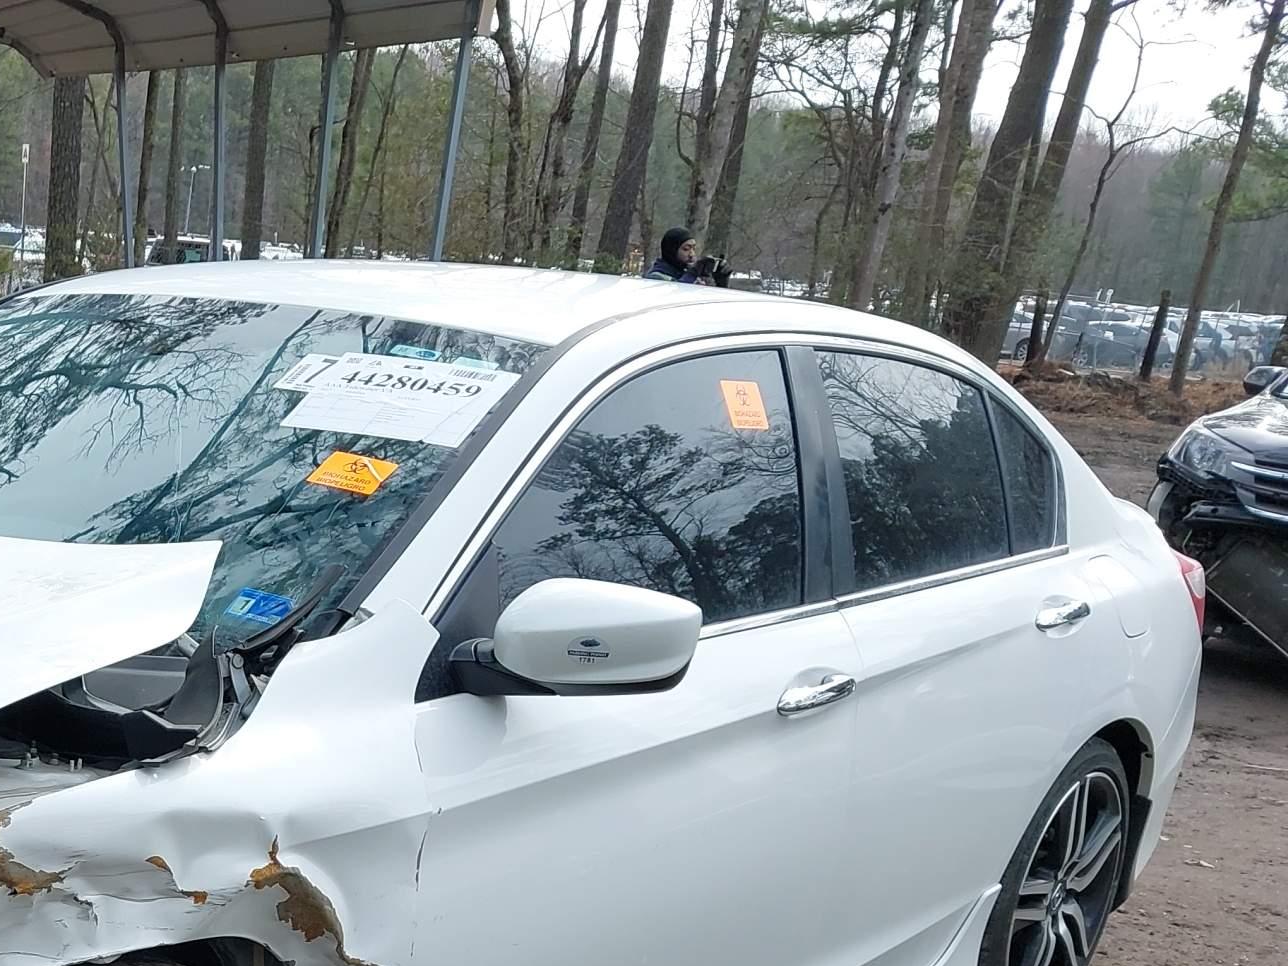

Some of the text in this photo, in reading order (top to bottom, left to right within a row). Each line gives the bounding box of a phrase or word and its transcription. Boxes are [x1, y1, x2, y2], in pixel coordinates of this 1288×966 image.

[340, 370, 482, 398] 44280459
[316, 477, 367, 491] BIOPELIGRO
[322, 471, 372, 485] BIOHAZARD
